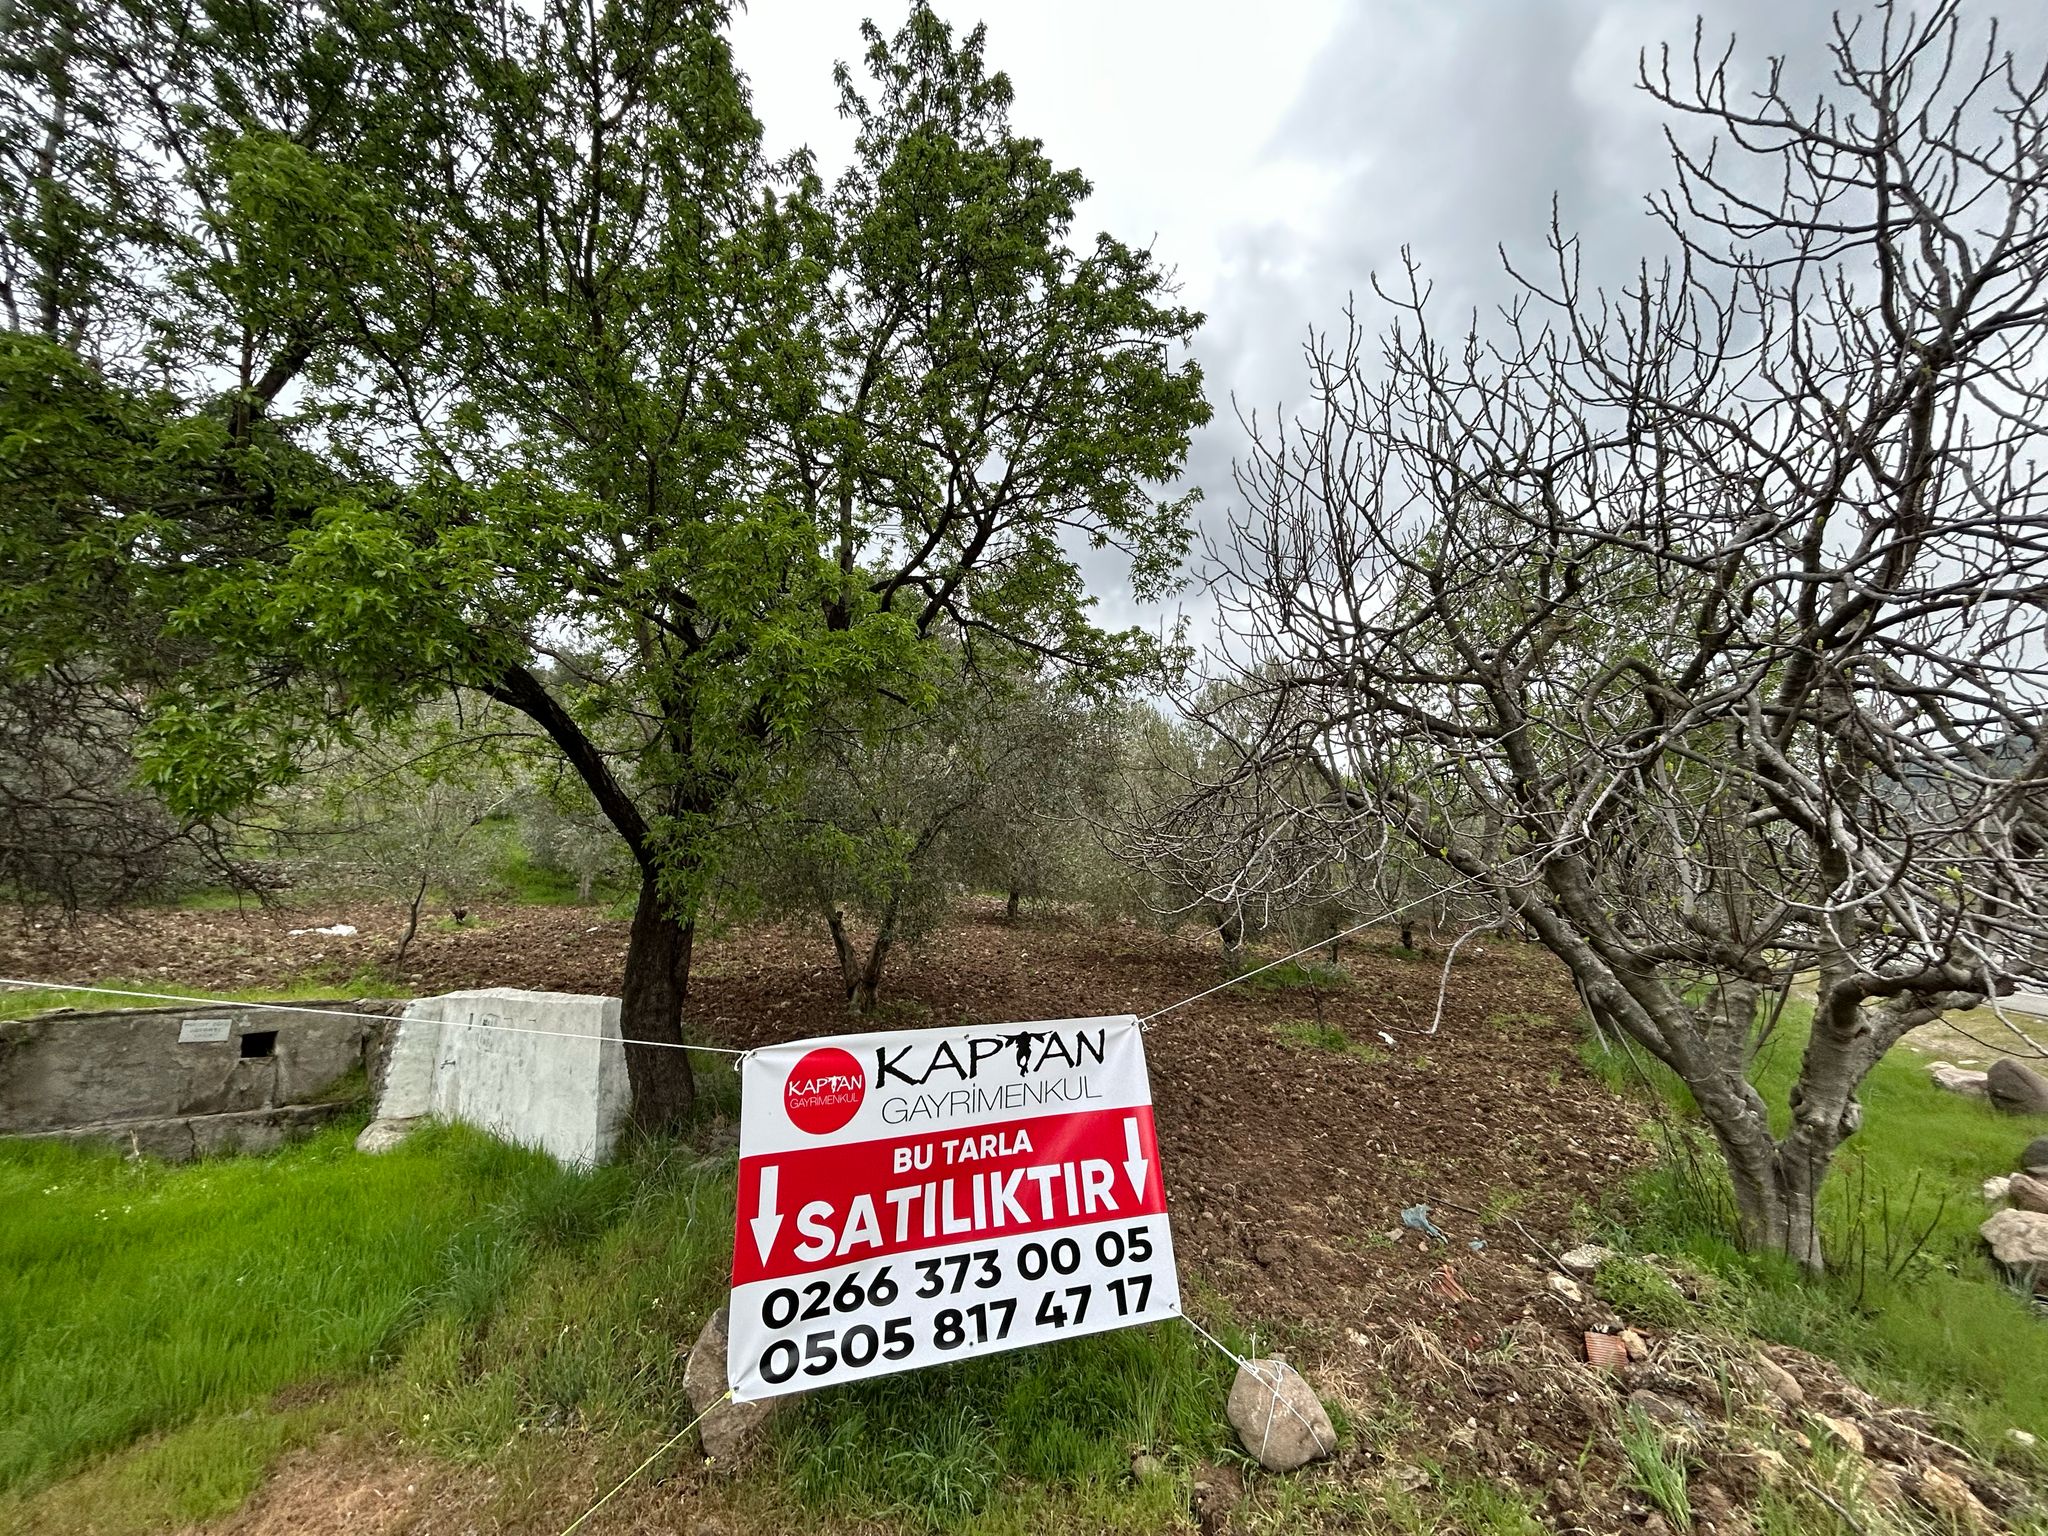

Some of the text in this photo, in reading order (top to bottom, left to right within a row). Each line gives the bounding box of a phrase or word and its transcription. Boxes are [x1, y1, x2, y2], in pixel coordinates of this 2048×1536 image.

[788, 1074, 862, 1096] KAPTAN
[875, 1029, 1105, 1089] KAPTAN
[789, 1094, 858, 1109] GAYRİMENKUL
[882, 1077, 1102, 1124] GAYRİMENKUL
[893, 1129, 1033, 1174] BU TARLA
[793, 1159, 1119, 1262] SATILIKTIR
[761, 1226, 1152, 1329] 0266 373 00 05
[759, 1275, 1152, 1384] 0505 817 47 17
